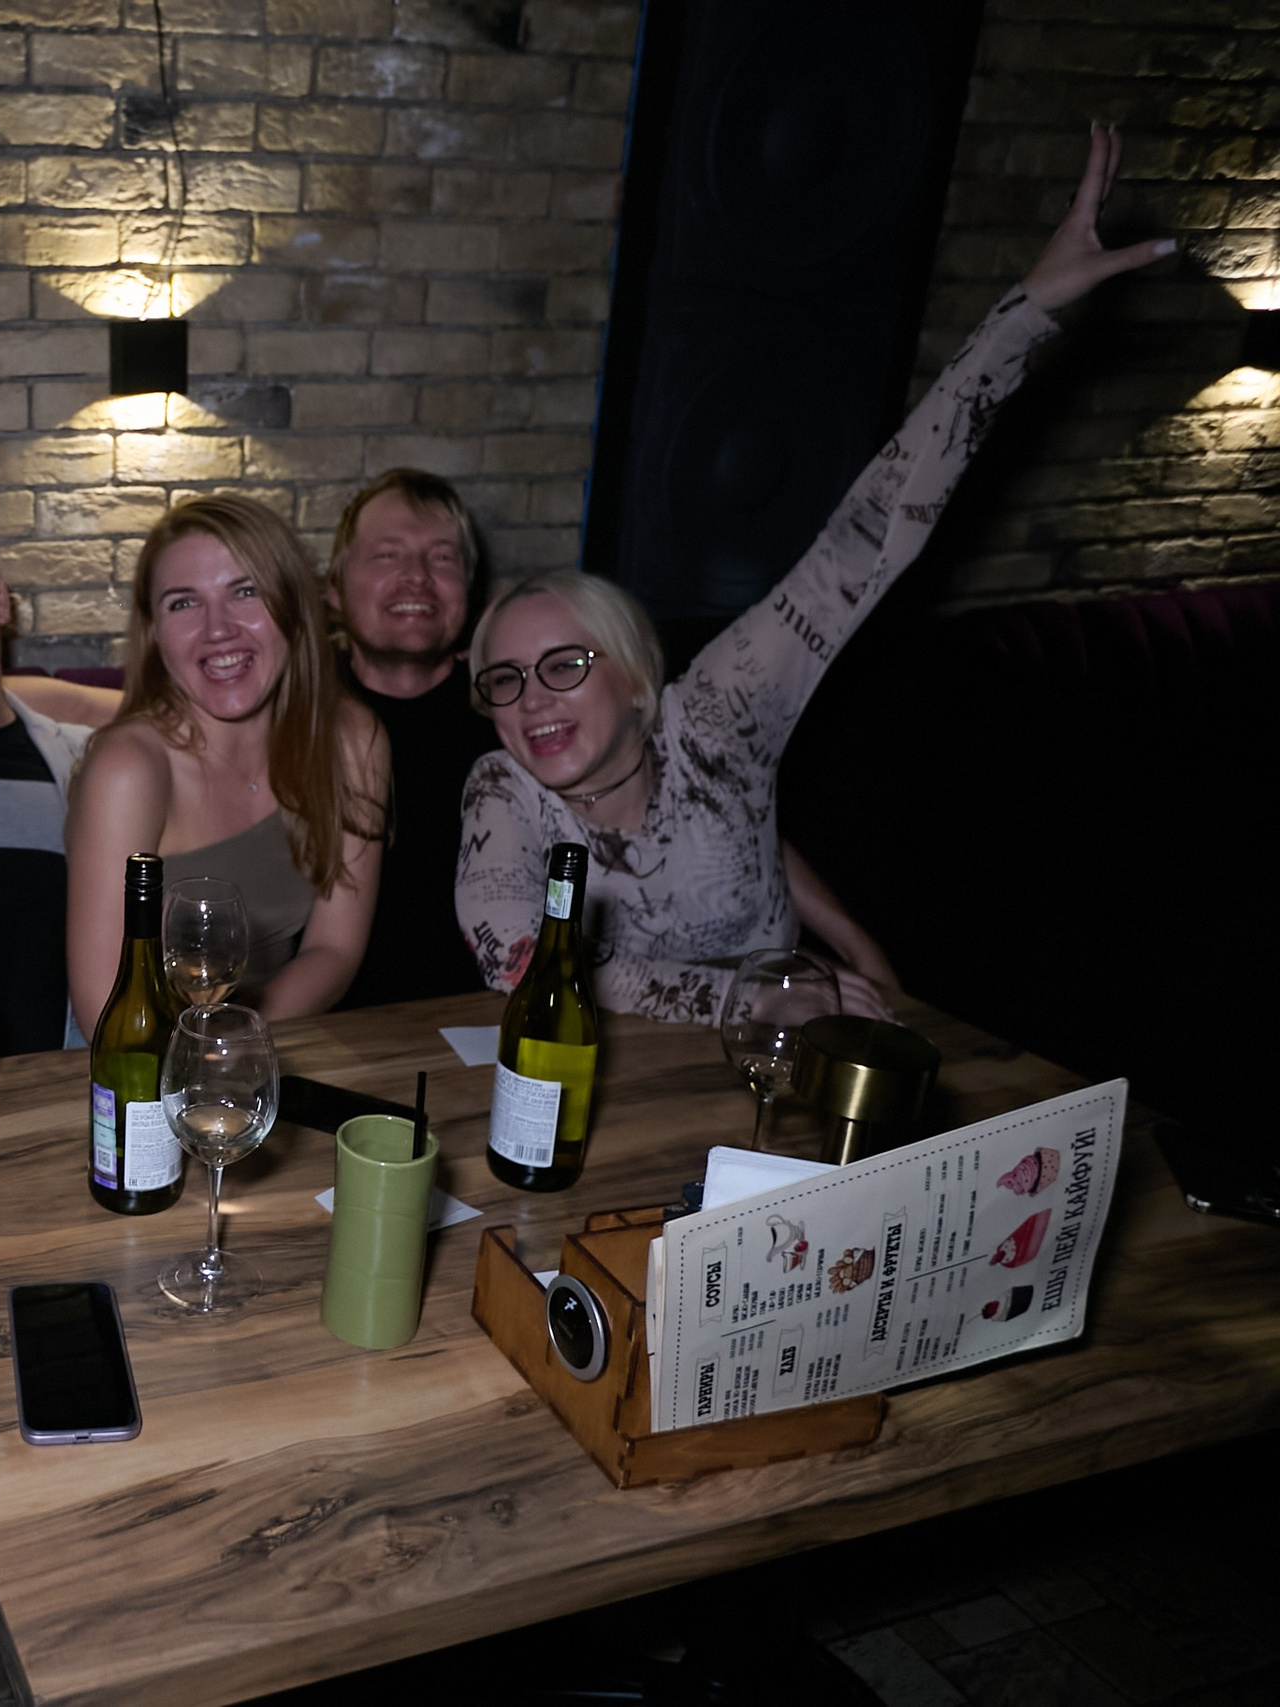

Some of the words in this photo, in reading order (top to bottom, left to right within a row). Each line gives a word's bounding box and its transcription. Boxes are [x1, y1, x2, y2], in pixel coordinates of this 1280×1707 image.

[1064, 1128, 1095, 1220] КАЙФУЙ!
[883, 1223, 902, 1276] ФРУКТЫ
[1052, 1222, 1080, 1264] ПЕЙ!
[706, 1261, 721, 1307] СОУСЫ
[880, 1278, 895, 1290] И
[1042, 1266, 1068, 1311] ЕШЬ!
[871, 1290, 893, 1342] ДЕСЕРТЫ
[780, 1346, 796, 1376] ХЛЕБ
[698, 1363, 714, 1417] ГАРНИРЫ
